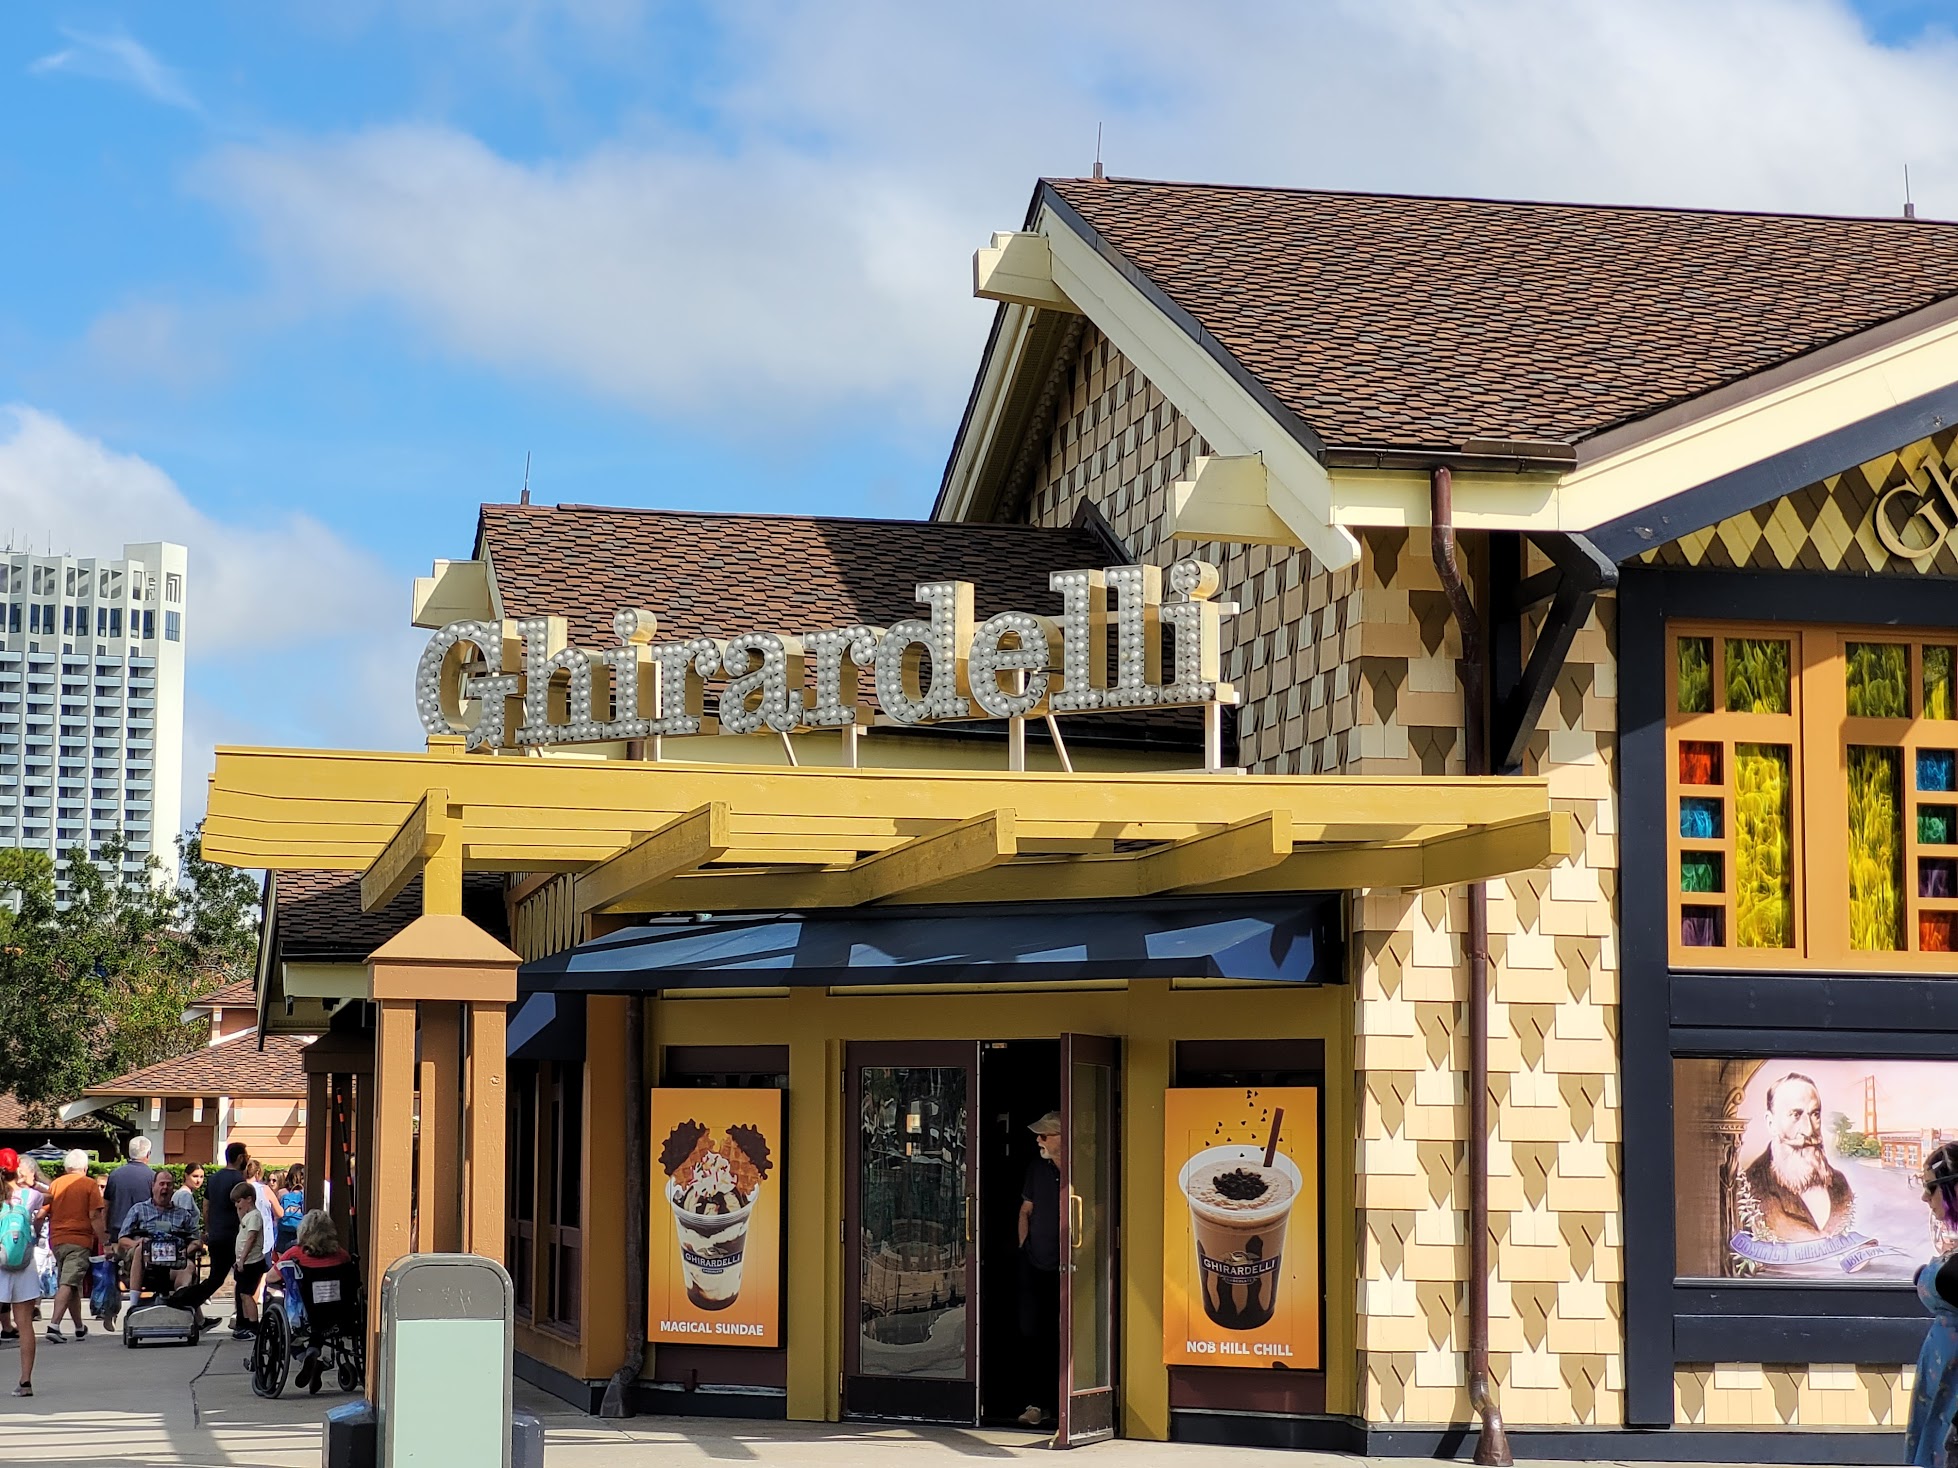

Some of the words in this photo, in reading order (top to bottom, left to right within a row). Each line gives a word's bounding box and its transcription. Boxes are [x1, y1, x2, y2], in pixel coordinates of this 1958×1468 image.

[416, 558, 1221, 751] Ghirardelli
[685, 1252, 741, 1267] GHIRARDELLI
[1203, 1258, 1275, 1276] GHIRARDELLI
[660, 1320, 713, 1334] MAGICAL
[715, 1323, 764, 1336] SUNDAE
[1186, 1340, 1217, 1354] NOB
[1220, 1342, 1250, 1355] HILL
[1253, 1343, 1294, 1357] CHILL
